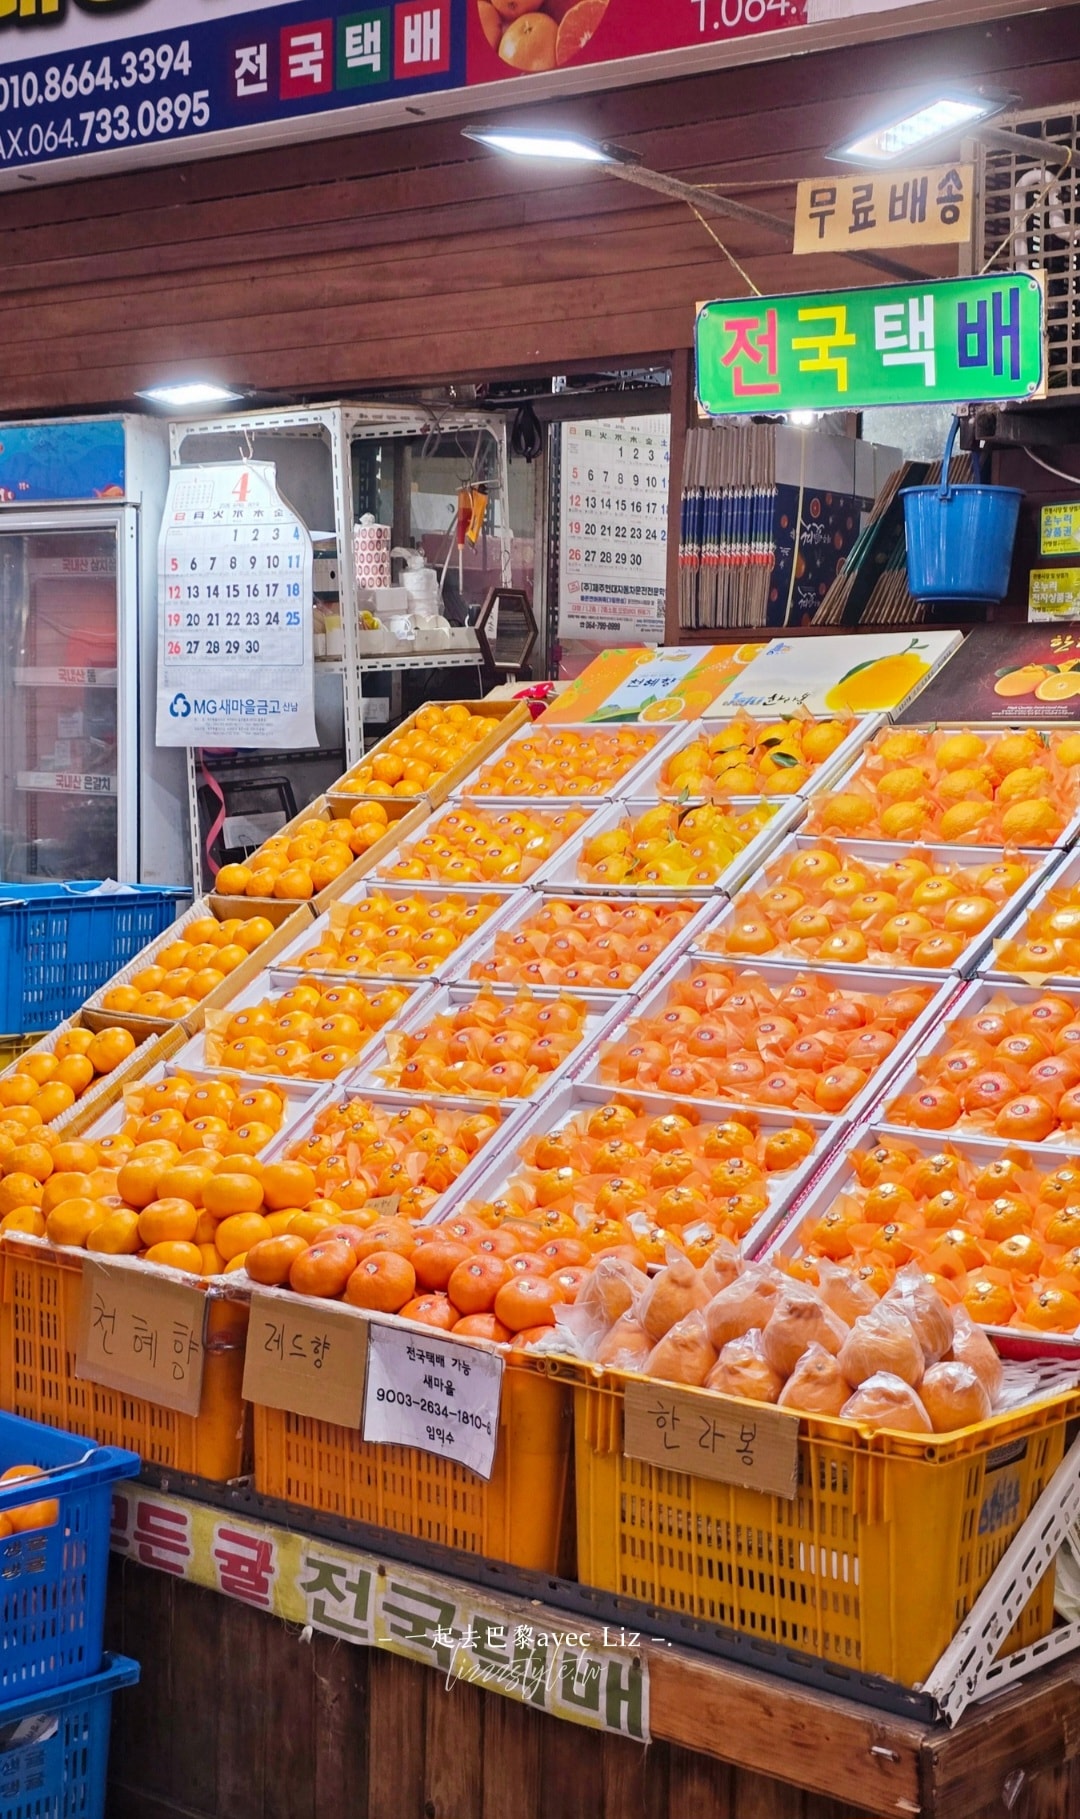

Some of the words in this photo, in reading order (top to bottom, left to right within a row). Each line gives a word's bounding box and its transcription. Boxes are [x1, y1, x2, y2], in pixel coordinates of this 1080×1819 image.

[235, 8, 440, 97] 전국택배
[0, 90, 209, 160] X.064.733.0895
[808, 169, 965, 239] 무료배송
[720, 287, 1020, 396] 전국택배
[619, 446, 623, 457] 1
[633, 448, 639, 459] 2
[649, 450, 654, 461] 3
[232, 472, 251, 502] 4
[572, 467, 578, 479] 5
[588, 469, 594, 481] 6
[603, 471, 609, 483] 7
[617, 473, 624, 484] 8
[633, 474, 639, 486] 9
[646, 476, 657, 488] 10
[662, 477, 669, 488] 1
[569, 494, 581, 507] 12
[585, 496, 596, 509] 13
[600, 498, 611, 510] 14
[615, 499, 627, 511] 15
[631, 501, 642, 513] 16
[646, 502, 657, 514] 17
[661, 504, 668, 515] 1
[233, 529, 238, 541] 1
[251, 529, 259, 541] 2
[272, 528, 280, 540] 3
[293, 526, 299, 540] 4
[569, 522, 581, 534] 19
[585, 523, 596, 535] 20
[600, 525, 611, 537] 21
[615, 526, 627, 538] 22
[630, 527, 642, 539] 23
[645, 529, 657, 540] 24
[661, 530, 666, 541] 2
[171, 558, 178, 571] 5
[190, 557, 197, 570] 6
[209, 557, 217, 570] 7
[229, 556, 237, 569] 8
[250, 556, 257, 569] 9
[266, 555, 280, 568] 10
[288, 555, 300, 568] 11
[569, 549, 581, 560] 26
[585, 550, 596, 562] 27
[600, 551, 612, 563] 28
[615, 552, 627, 564] 29
[630, 554, 642, 566] 30
[169, 586, 181, 599] 12
[187, 586, 200, 599] 13
[206, 585, 219, 598] 14
[226, 585, 240, 598] 15
[246, 584, 260, 597] 16
[266, 583, 279, 597] 17
[287, 583, 300, 596] 18
[168, 614, 180, 626] 19
[186, 613, 200, 626] 20
[207, 613, 220, 626] 21
[226, 613, 240, 626] 22
[246, 613, 260, 626] 23
[265, 612, 280, 626] 24
[286, 612, 301, 626] 25
[168, 641, 181, 654] 26
[186, 641, 200, 654] 27
[206, 641, 220, 654] 28
[225, 641, 240, 654] 29
[245, 640, 260, 653] 30
[55, 774, 81, 789] 국내산
[93, 1293, 200, 1380] 천혜향
[264, 1323, 331, 1369] 레드향
[406, 1346, 445, 1368] 전국택배
[451, 1358, 472, 1377] 가능
[423, 1374, 456, 1397] 새마을
[426, 1425, 455, 1445] 임익수
[647, 1401, 757, 1466] 한라봉
